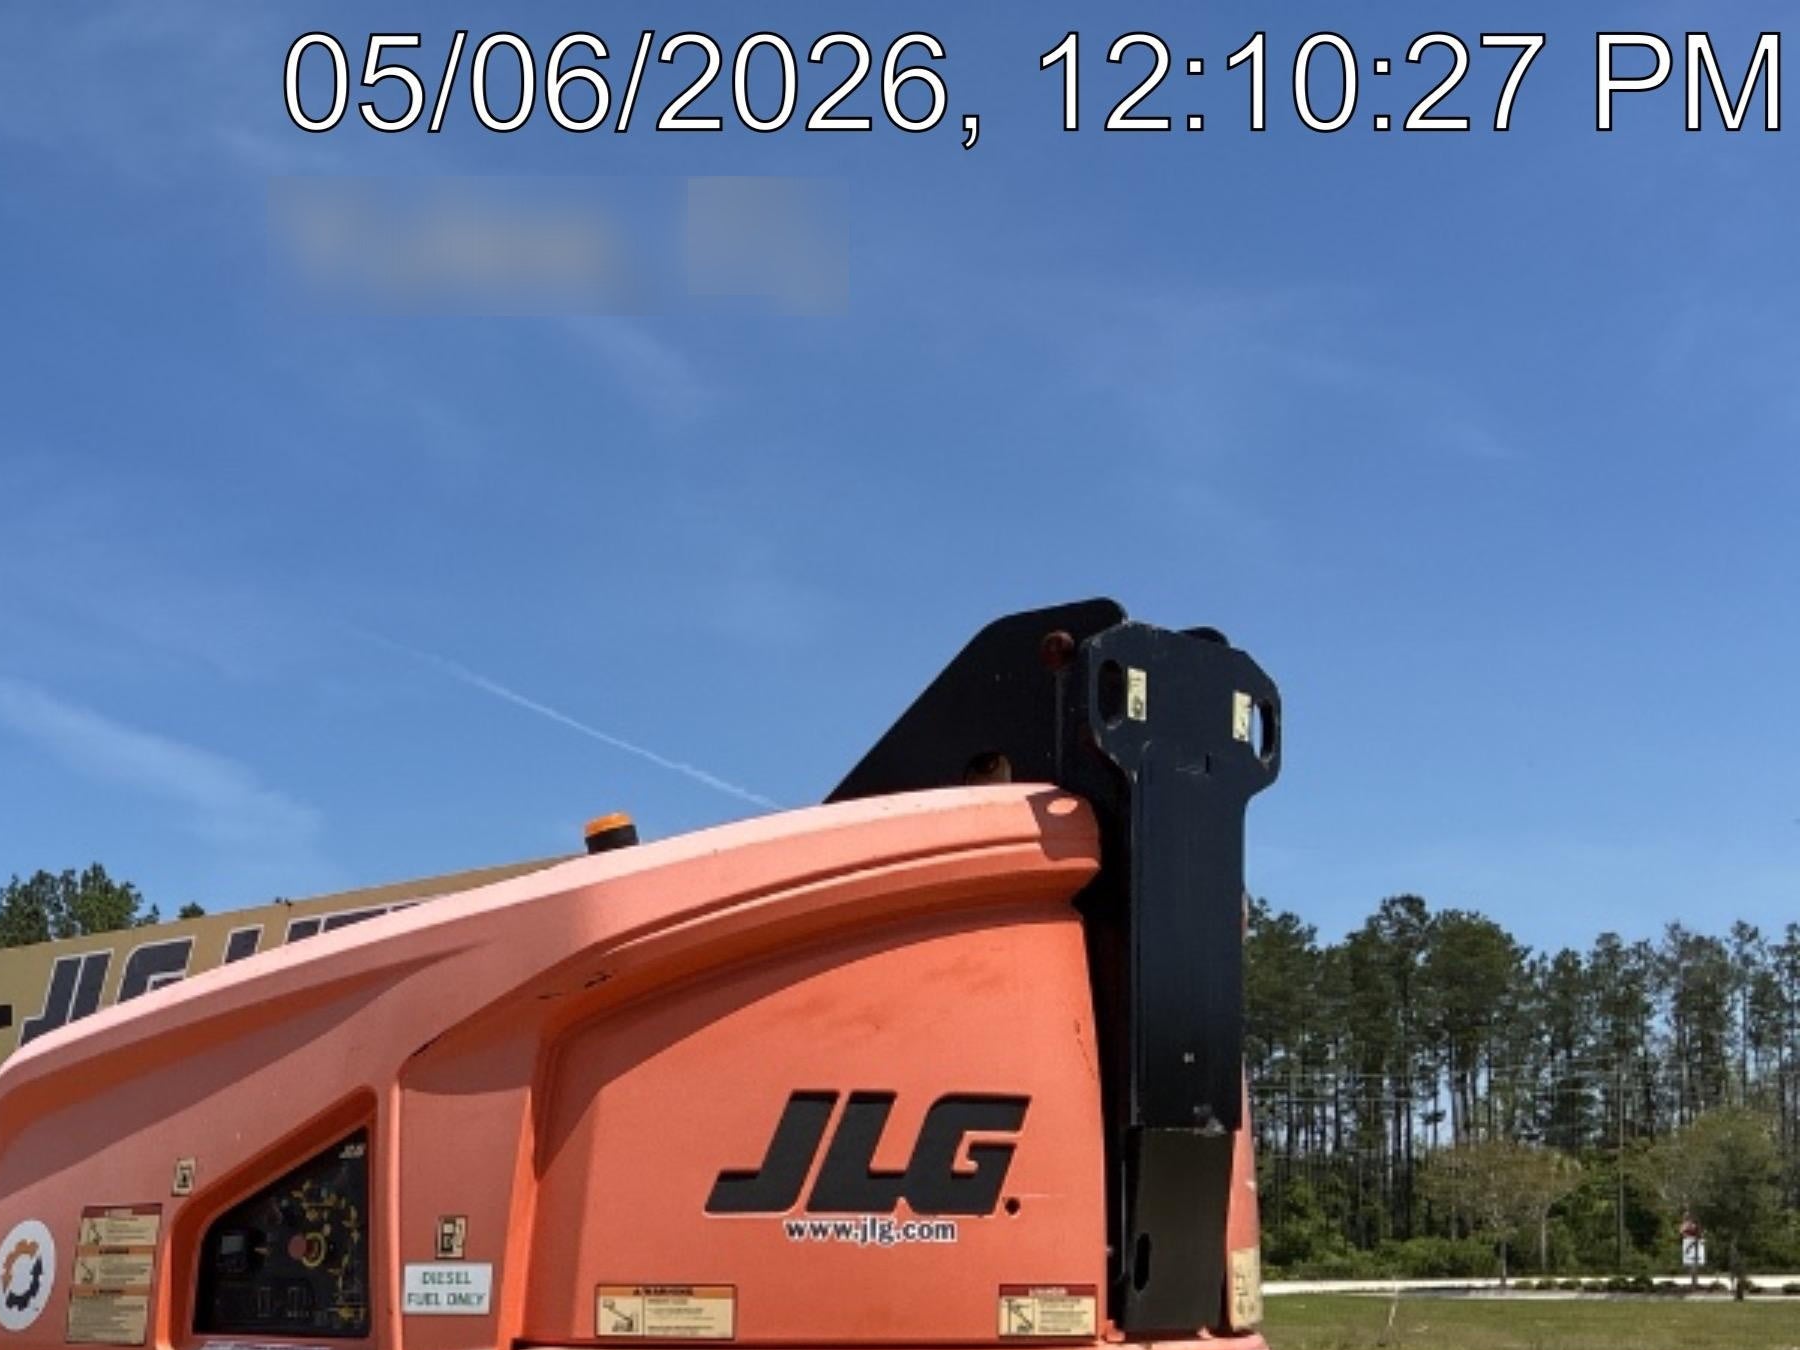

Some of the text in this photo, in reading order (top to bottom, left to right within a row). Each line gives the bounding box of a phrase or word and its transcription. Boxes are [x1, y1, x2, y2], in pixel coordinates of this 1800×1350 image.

[703, 1088, 1033, 1216] JLG
[784, 1218, 957, 1244] www.jlg.com
[421, 1271, 472, 1285] DIESEL
[407, 1292, 487, 1306] FUEL ONLY
